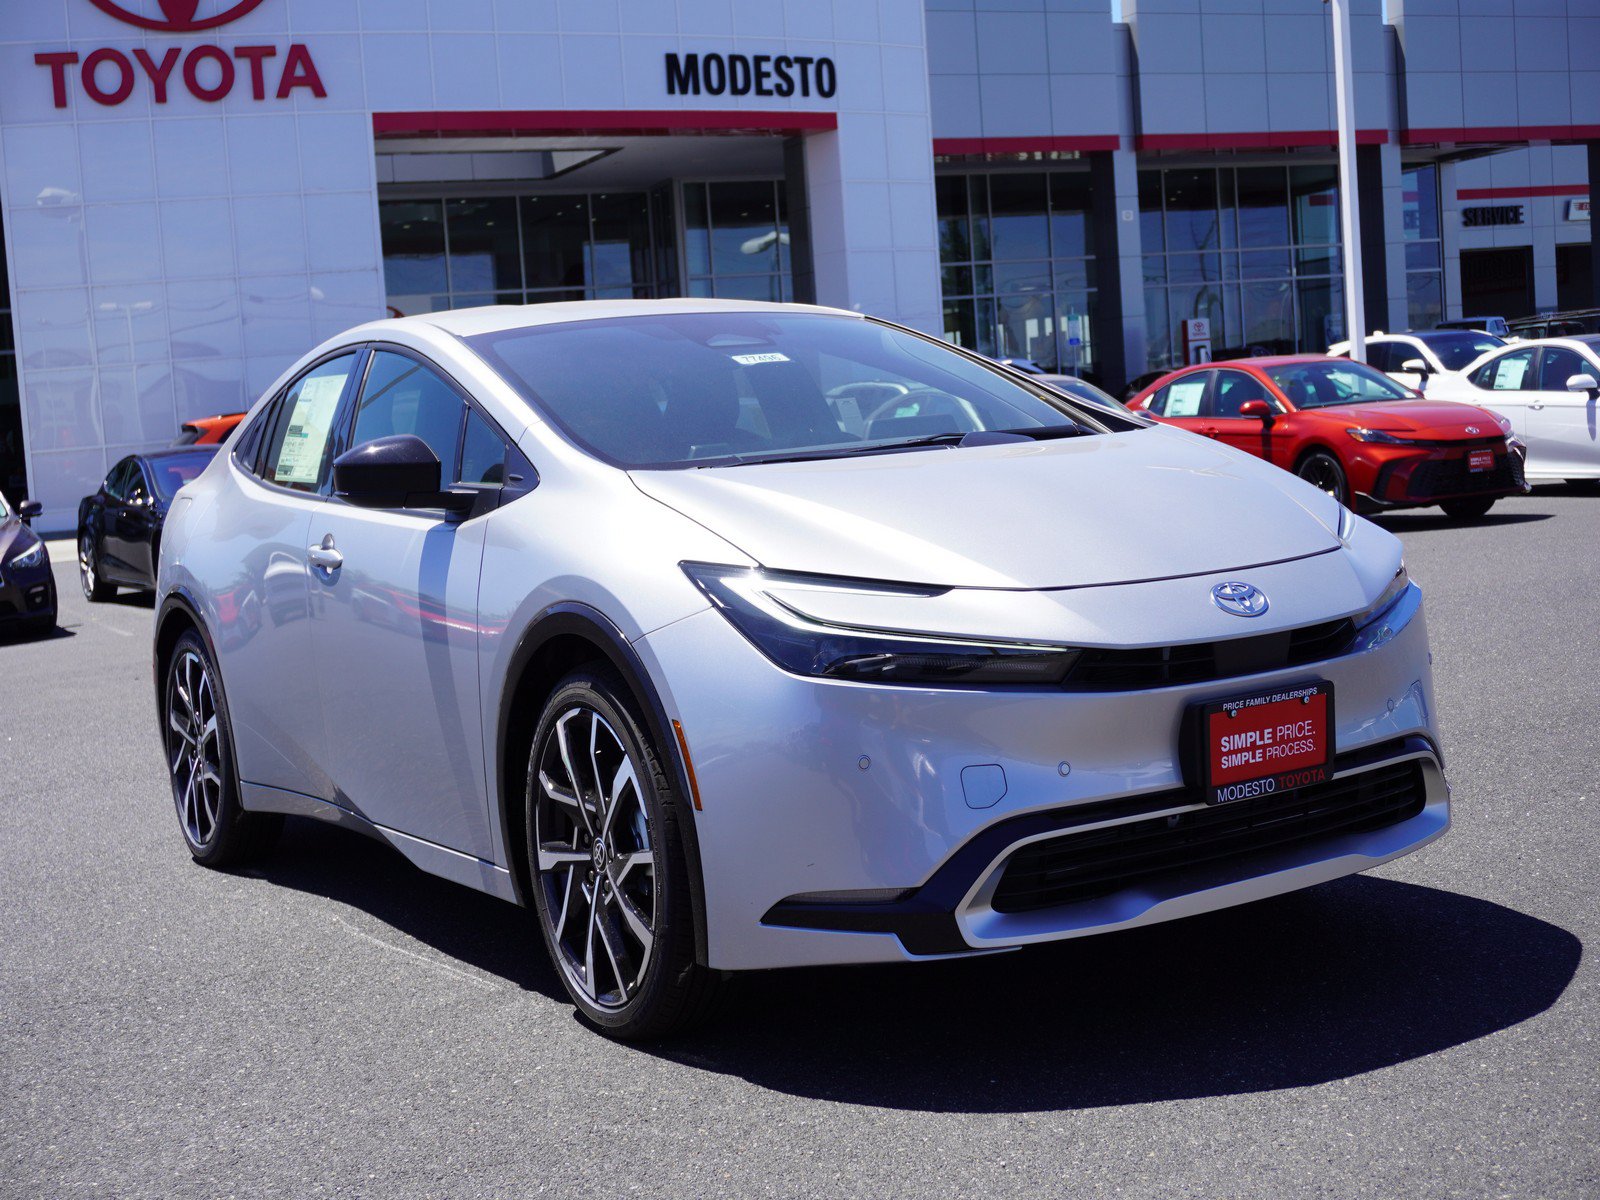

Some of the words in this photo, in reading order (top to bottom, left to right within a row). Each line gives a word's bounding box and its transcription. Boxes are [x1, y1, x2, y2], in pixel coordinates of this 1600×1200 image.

[34, 44, 327, 108] TOYOTA
[665, 53, 836, 98] MODESTO
[1462, 205, 1524, 227] SERVICE
[1223, 700, 1244, 711] PRICE
[1245, 696, 1271, 707] FAMILY
[1271, 687, 1318, 702] DEALERSHIPS
[1220, 728, 1273, 752] SIMPLE
[1276, 720, 1316, 742] PRICE.
[1221, 749, 1263, 769] SIMPLE
[1266, 739, 1317, 760] PROCESS.
[1217, 778, 1276, 803] MODESTO
[1279, 770, 1326, 788] TOYOTA
